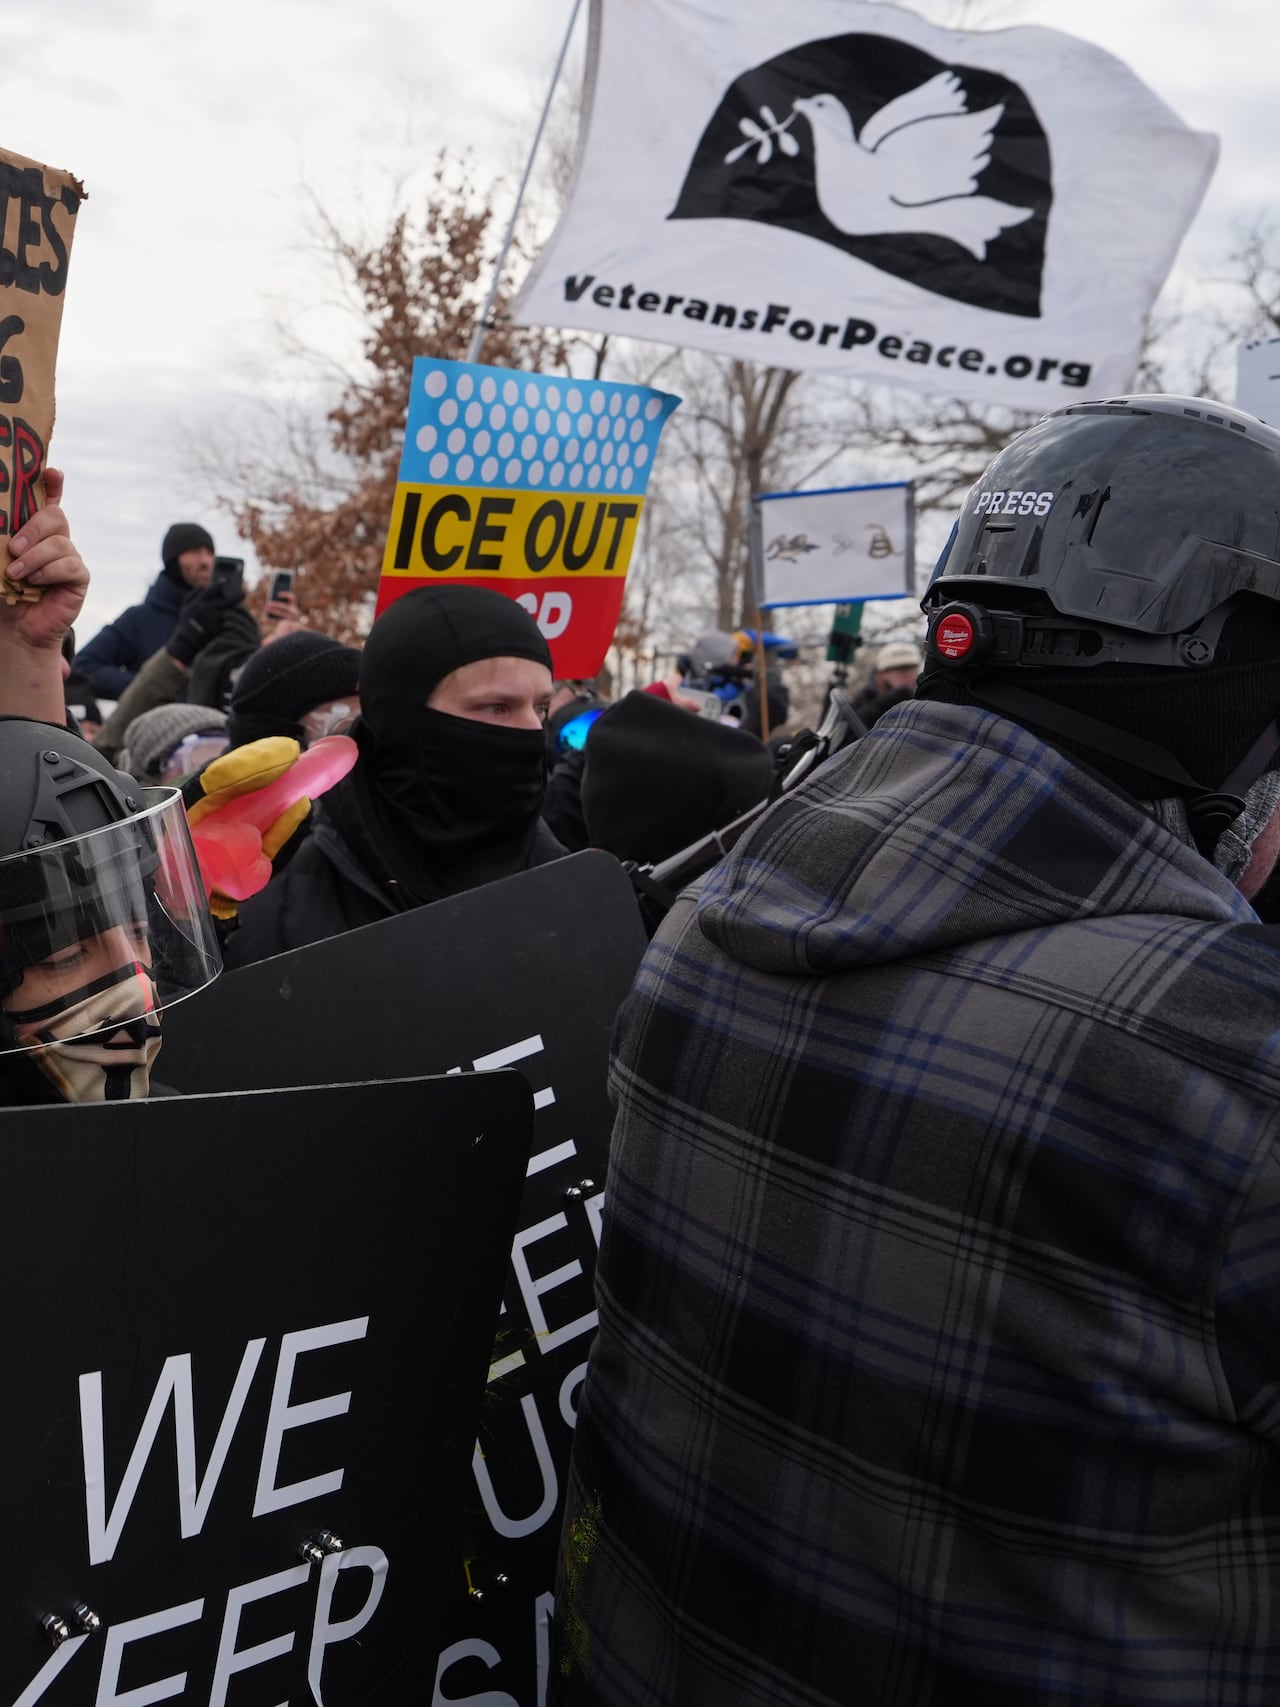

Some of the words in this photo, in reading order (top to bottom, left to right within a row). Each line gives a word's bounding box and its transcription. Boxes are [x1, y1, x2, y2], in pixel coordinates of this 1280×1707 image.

[564, 275, 1091, 388] VeteransForPeace.org
[393, 492, 516, 572] ICE
[523, 499, 639, 573] OUT
[973, 491, 1054, 516] PRESS
[78, 1315, 370, 1566] WE
